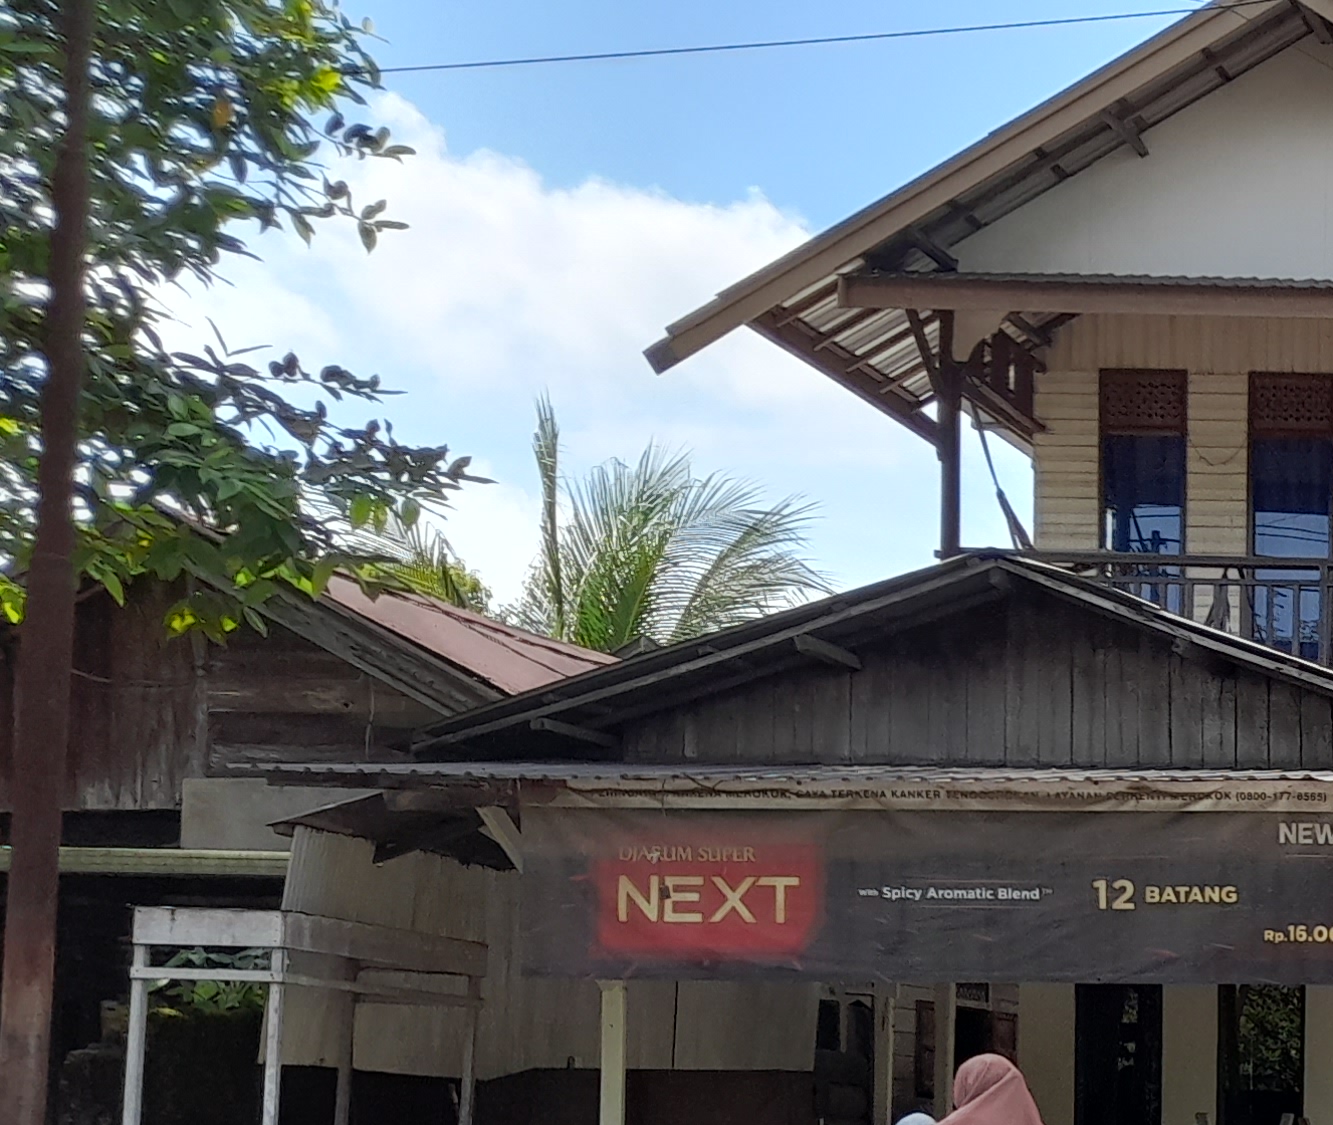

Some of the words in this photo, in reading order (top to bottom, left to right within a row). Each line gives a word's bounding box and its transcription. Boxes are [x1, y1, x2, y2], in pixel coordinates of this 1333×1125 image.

[891, 789, 941, 799] KANKER
[697, 846, 756, 862] SUPER
[617, 874, 800, 924] NEXT
[881, 886, 922, 901] Spicy
[926, 887, 994, 900] Aromatic
[1092, 879, 1136, 910] 12
[1144, 885, 1238, 904] BATANG
